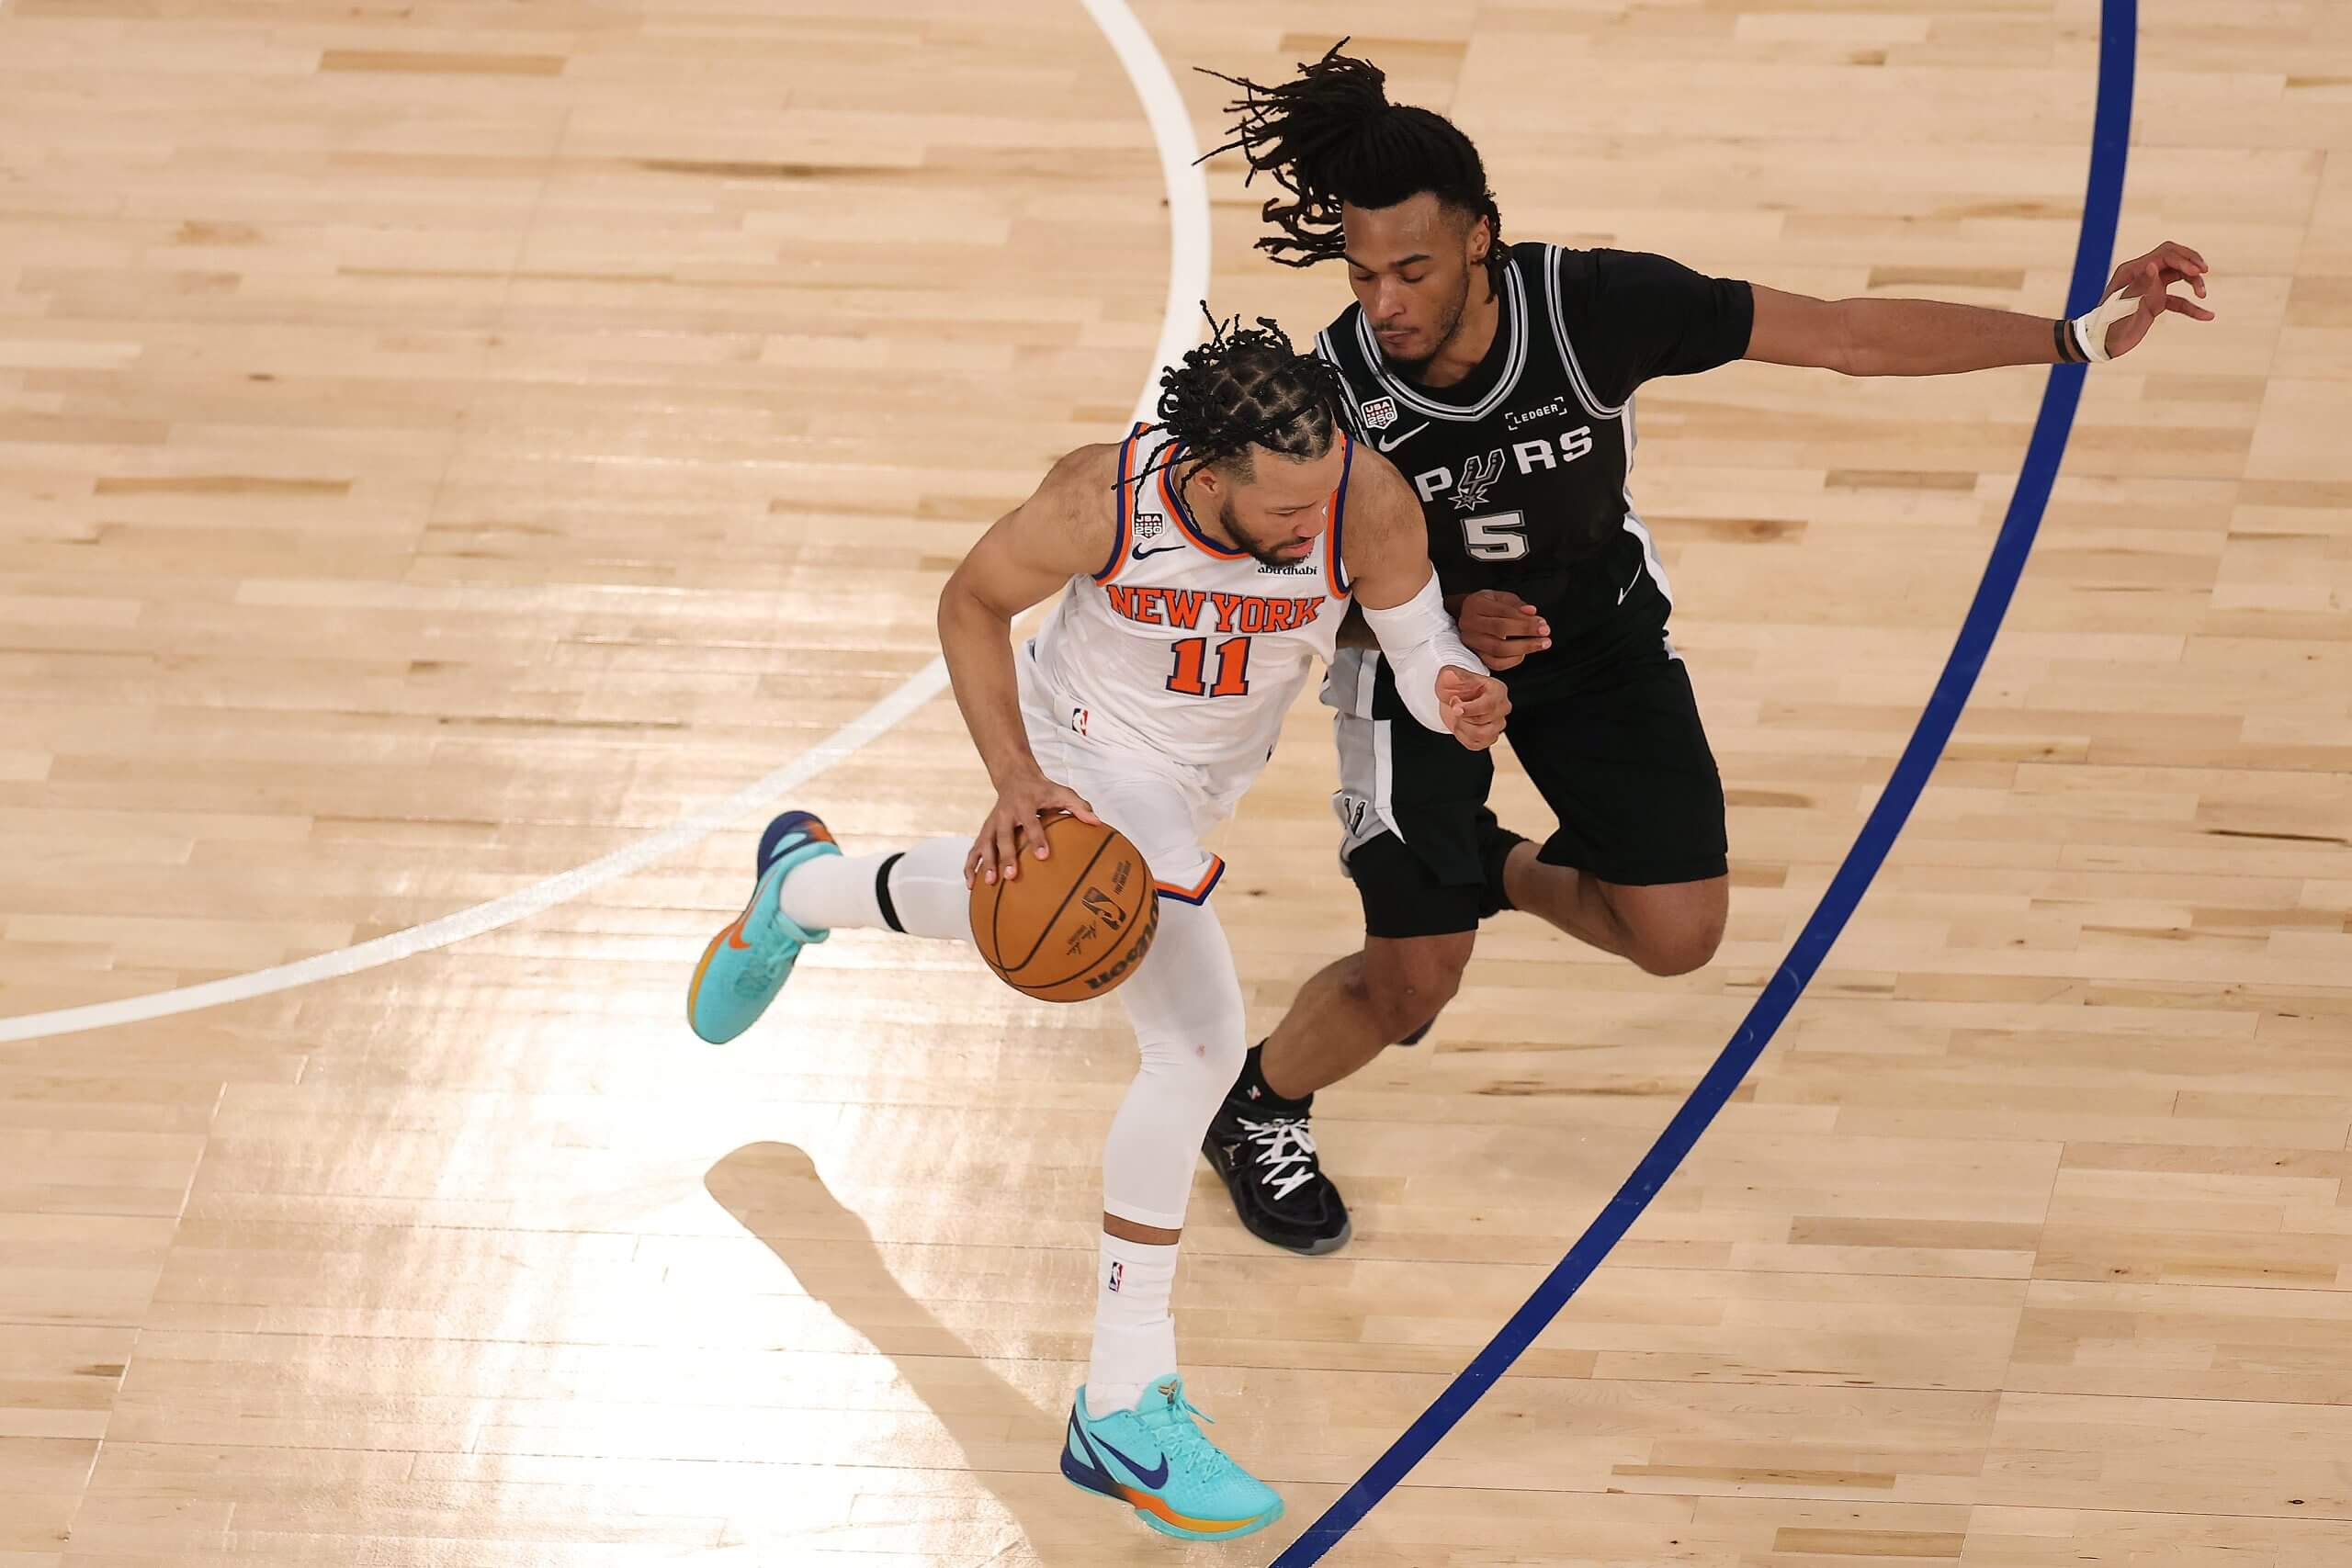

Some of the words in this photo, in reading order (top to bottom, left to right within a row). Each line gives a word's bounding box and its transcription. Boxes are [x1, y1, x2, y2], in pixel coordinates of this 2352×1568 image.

[1365, 401, 1390, 413] USA
[1367, 412, 1395, 425] 250
[1513, 403, 1559, 424] LEDGER
[1414, 425, 1593, 511] PURS
[1135, 525, 1162, 535] 250
[1460, 509, 1530, 562] 5
[1106, 584, 1206, 631] NEW
[1211, 589, 1327, 634] YORK
[1165, 636, 1252, 699] 11
